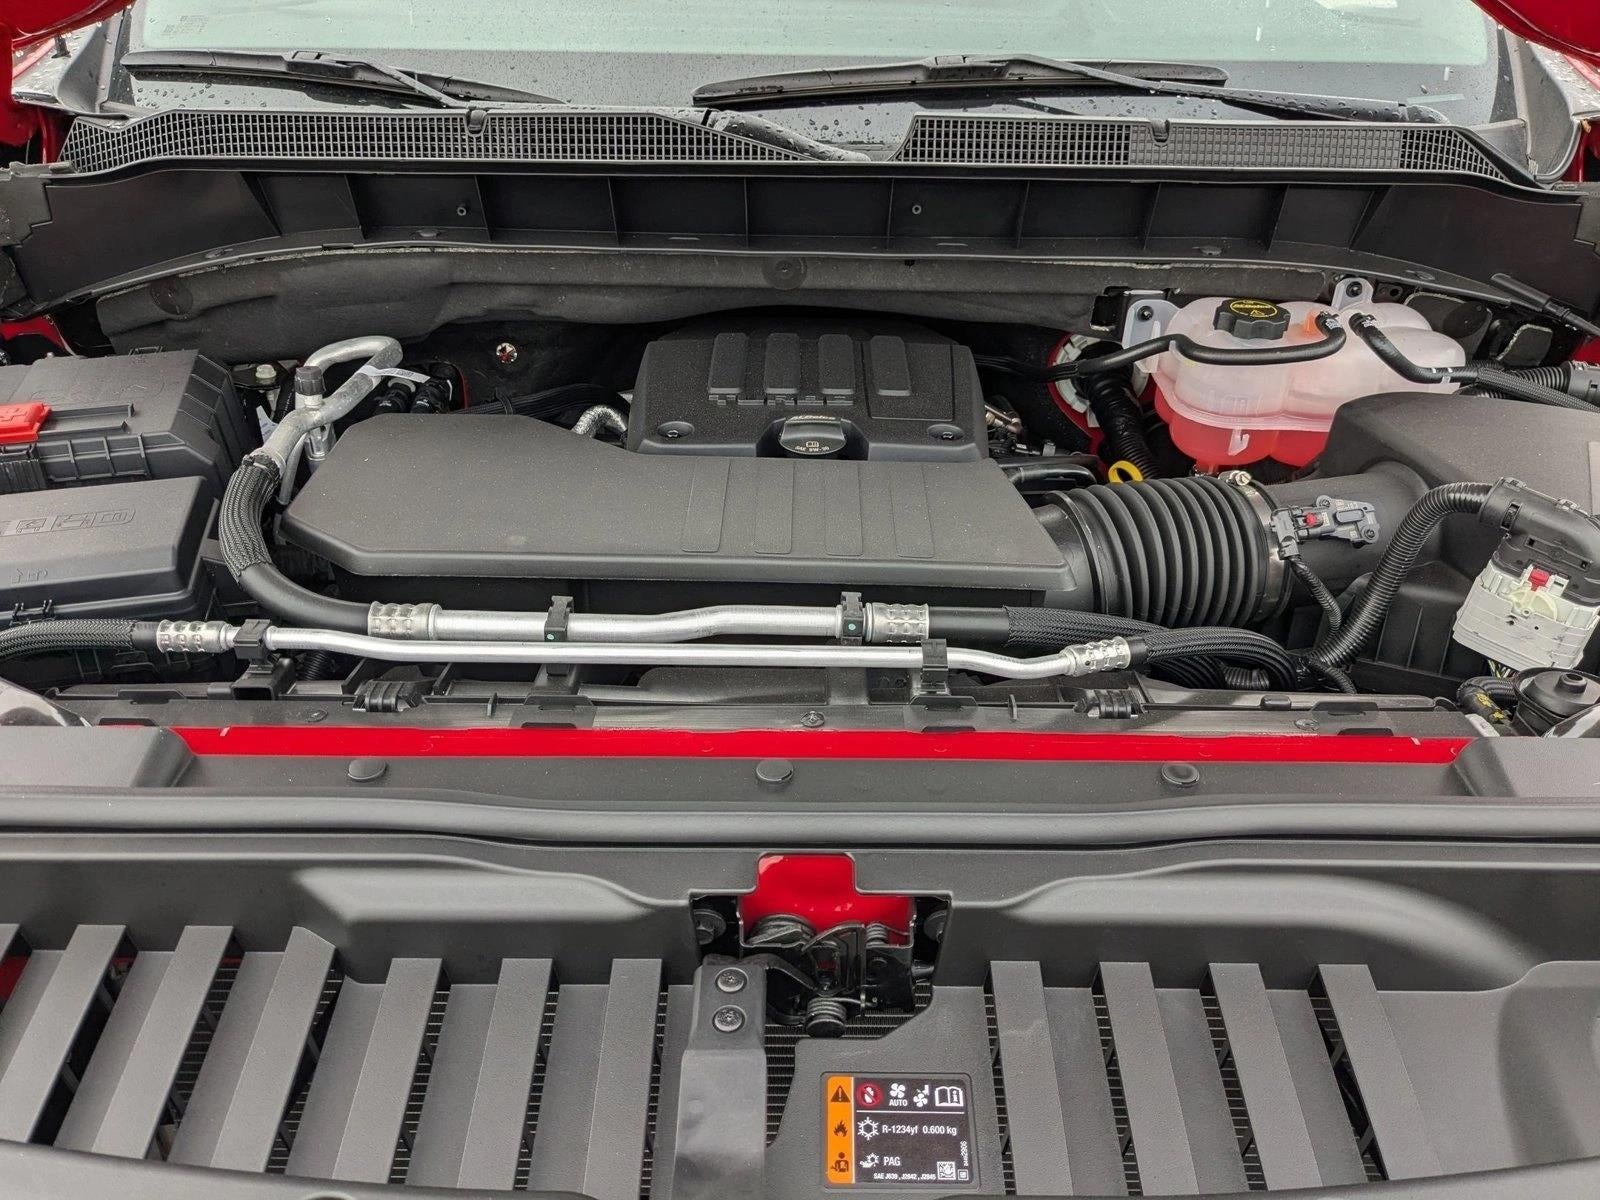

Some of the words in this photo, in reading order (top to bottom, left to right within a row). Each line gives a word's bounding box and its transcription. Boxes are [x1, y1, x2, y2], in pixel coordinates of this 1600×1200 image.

[889, 1099, 908, 1107] AUTO
[882, 1125, 919, 1136] R-1234yf
[922, 1125, 945, 1135] 0.600
[946, 1126, 957, 1136] kg
[883, 1156, 901, 1167] PAG
[873, 1172, 884, 1180] SAE
